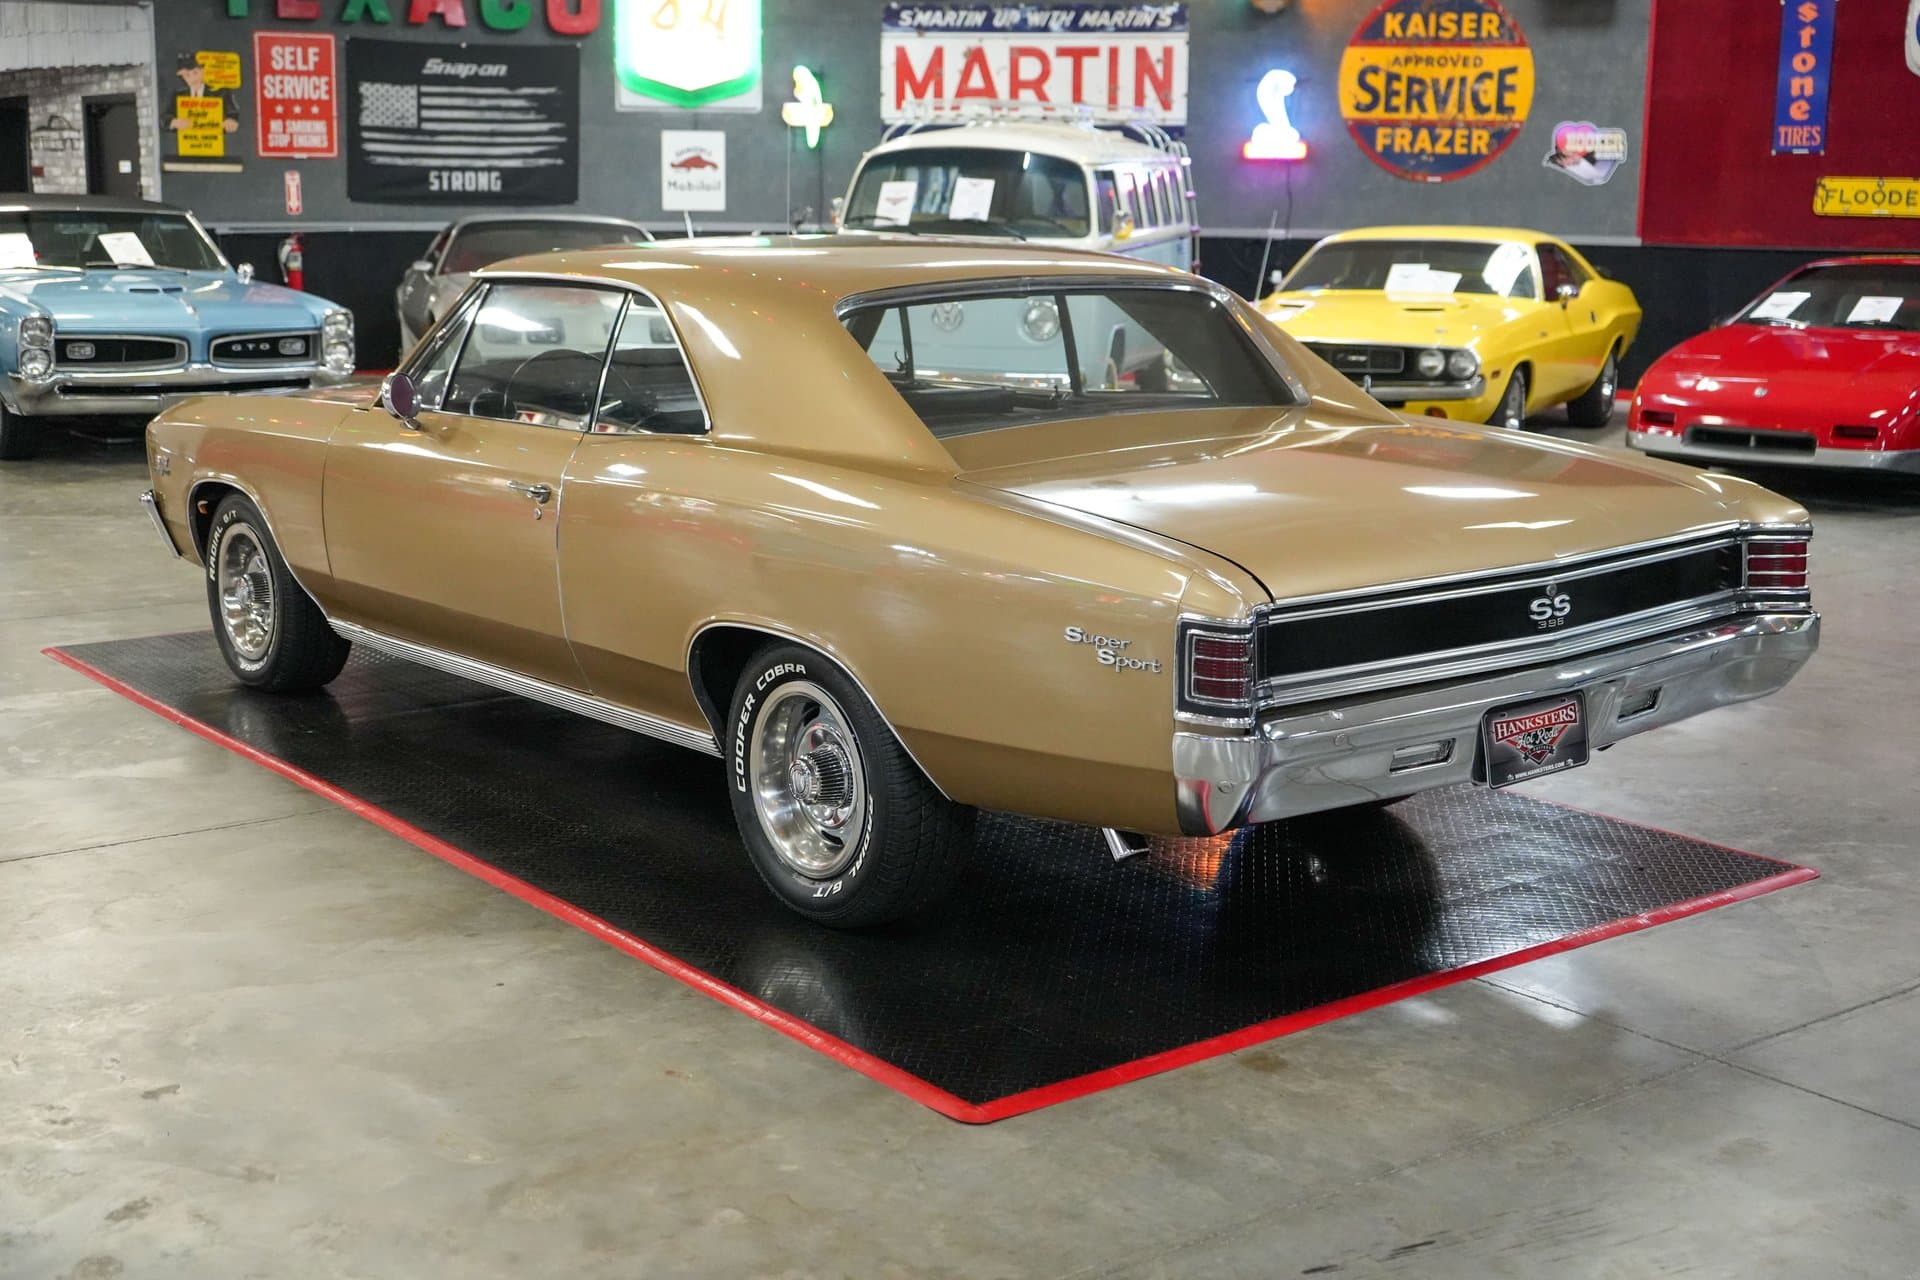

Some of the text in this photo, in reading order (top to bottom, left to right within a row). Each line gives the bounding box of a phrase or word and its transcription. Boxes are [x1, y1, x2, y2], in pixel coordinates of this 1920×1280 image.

[1384, 12, 1501, 38] KAISER
[271, 46, 320, 71] SELF
[1391, 55, 1484, 69] APPROVED
[263, 74, 330, 100] SERVICE
[895, 45, 1174, 112] MARTIN
[1354, 64, 1519, 115] SERVICE
[1375, 126, 1492, 155] FRAZER
[1778, 125, 1822, 147] TIRES
[428, 170, 502, 193] STRONG
[231, 342, 271, 352] GTO
[208, 525, 224, 582] RADIAL
[1529, 594, 1571, 620] SS
[1537, 617, 1565, 629] 396
[1064, 626, 1131, 651] Super
[1097, 648, 1162, 673] Sport
[735, 663, 807, 793] COOPER COBRA
[1495, 705, 1576, 740] HANKSTERS
[813, 793, 874, 898] RADIAL G/T
